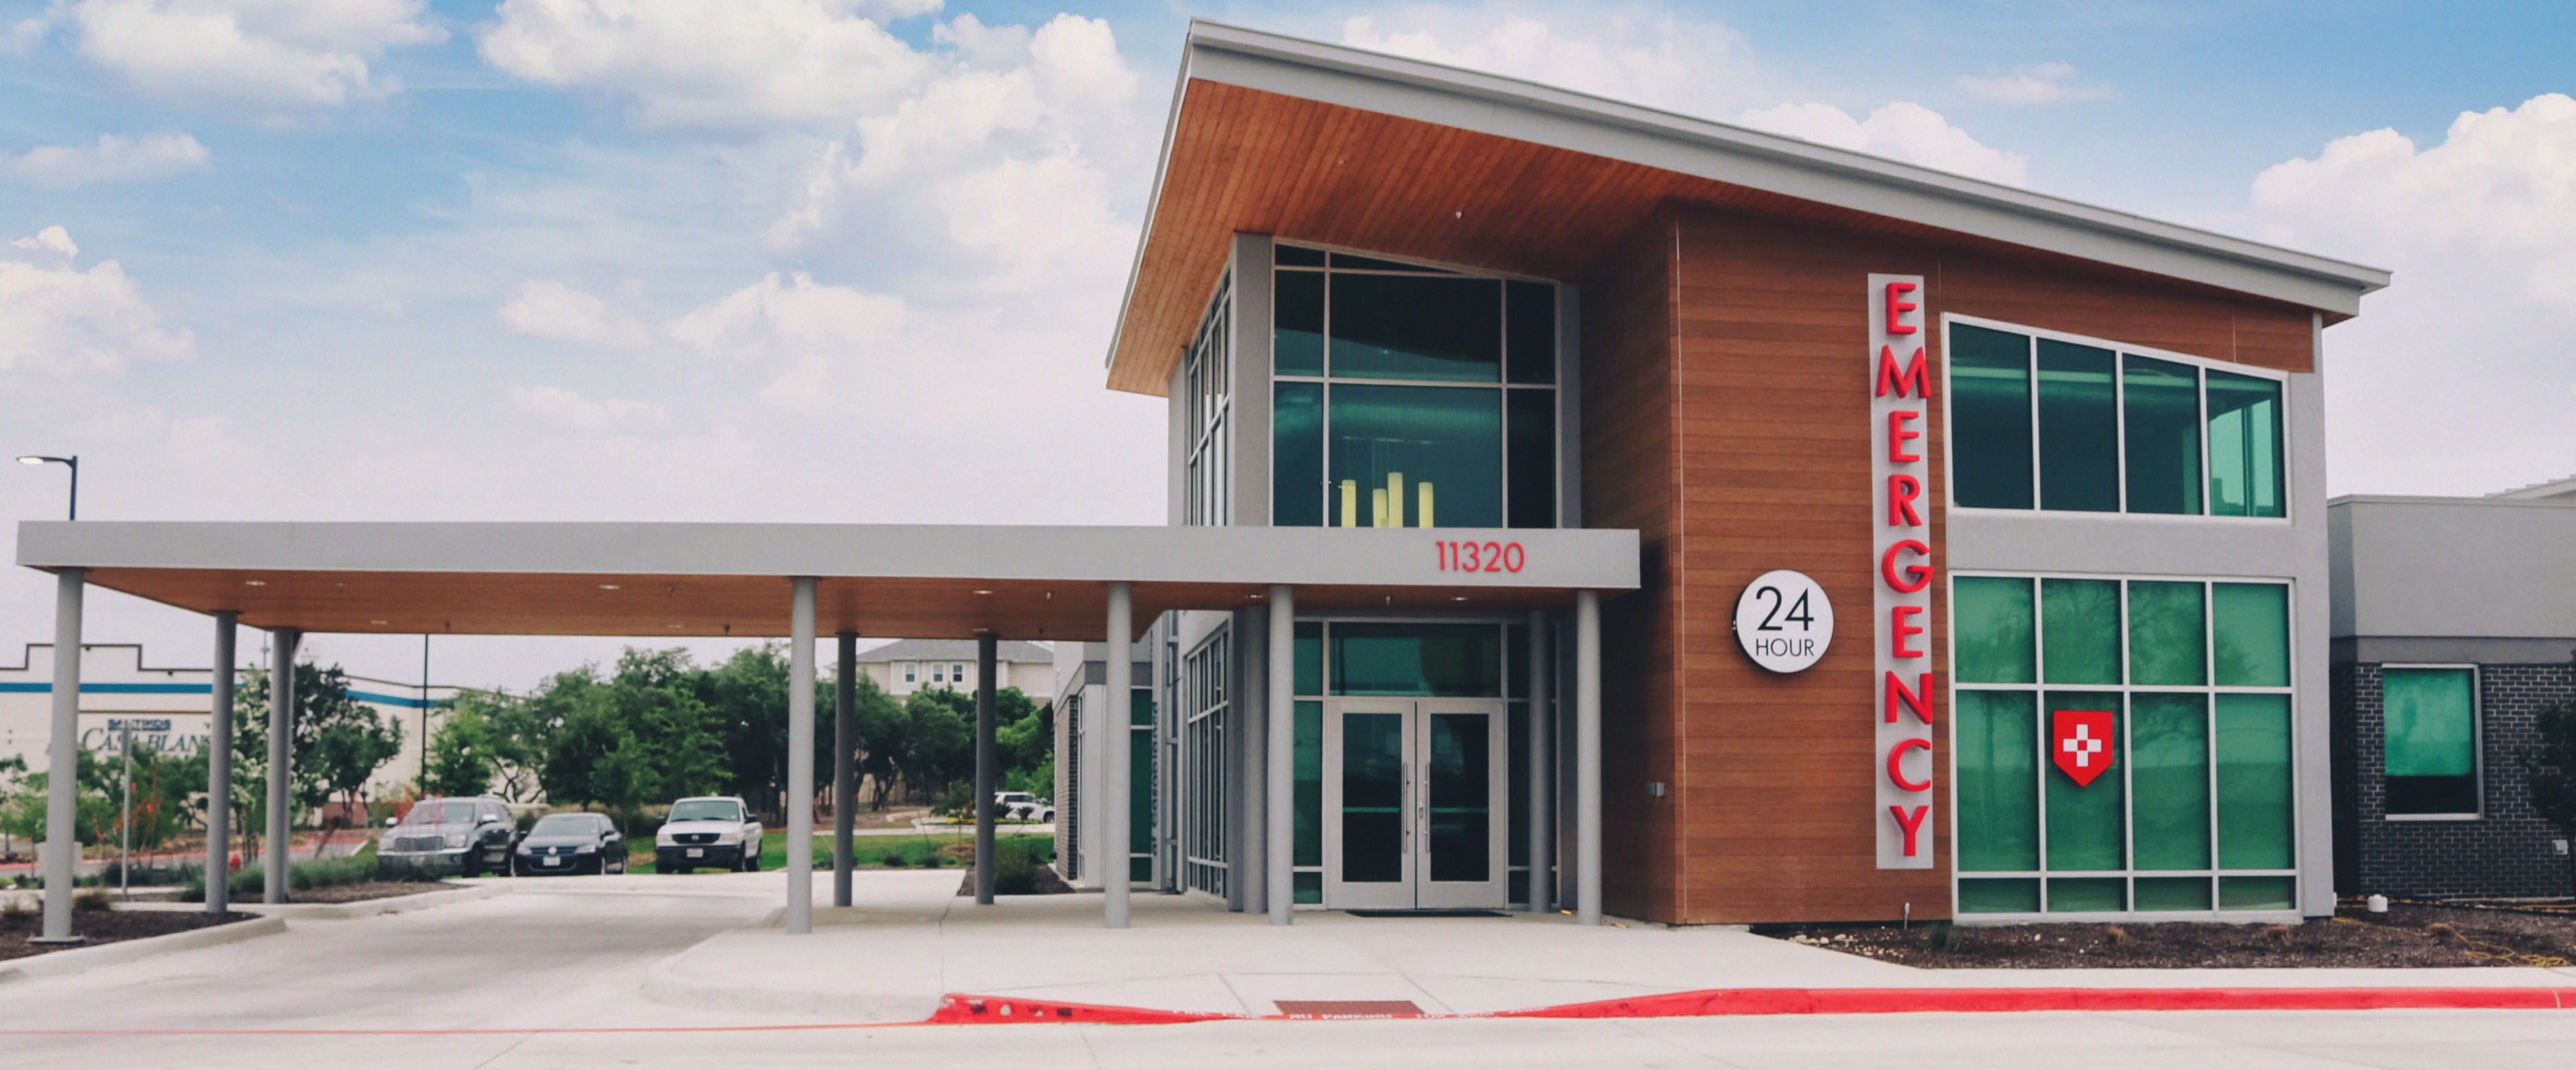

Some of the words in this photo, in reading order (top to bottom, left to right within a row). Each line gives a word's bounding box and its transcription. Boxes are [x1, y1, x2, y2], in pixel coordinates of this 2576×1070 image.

[1436, 540, 1525, 573] 11320
[1876, 282, 1934, 857] EMERGENCY
[1756, 586, 1815, 631] 24
[1756, 638, 1815, 657] HOUR
